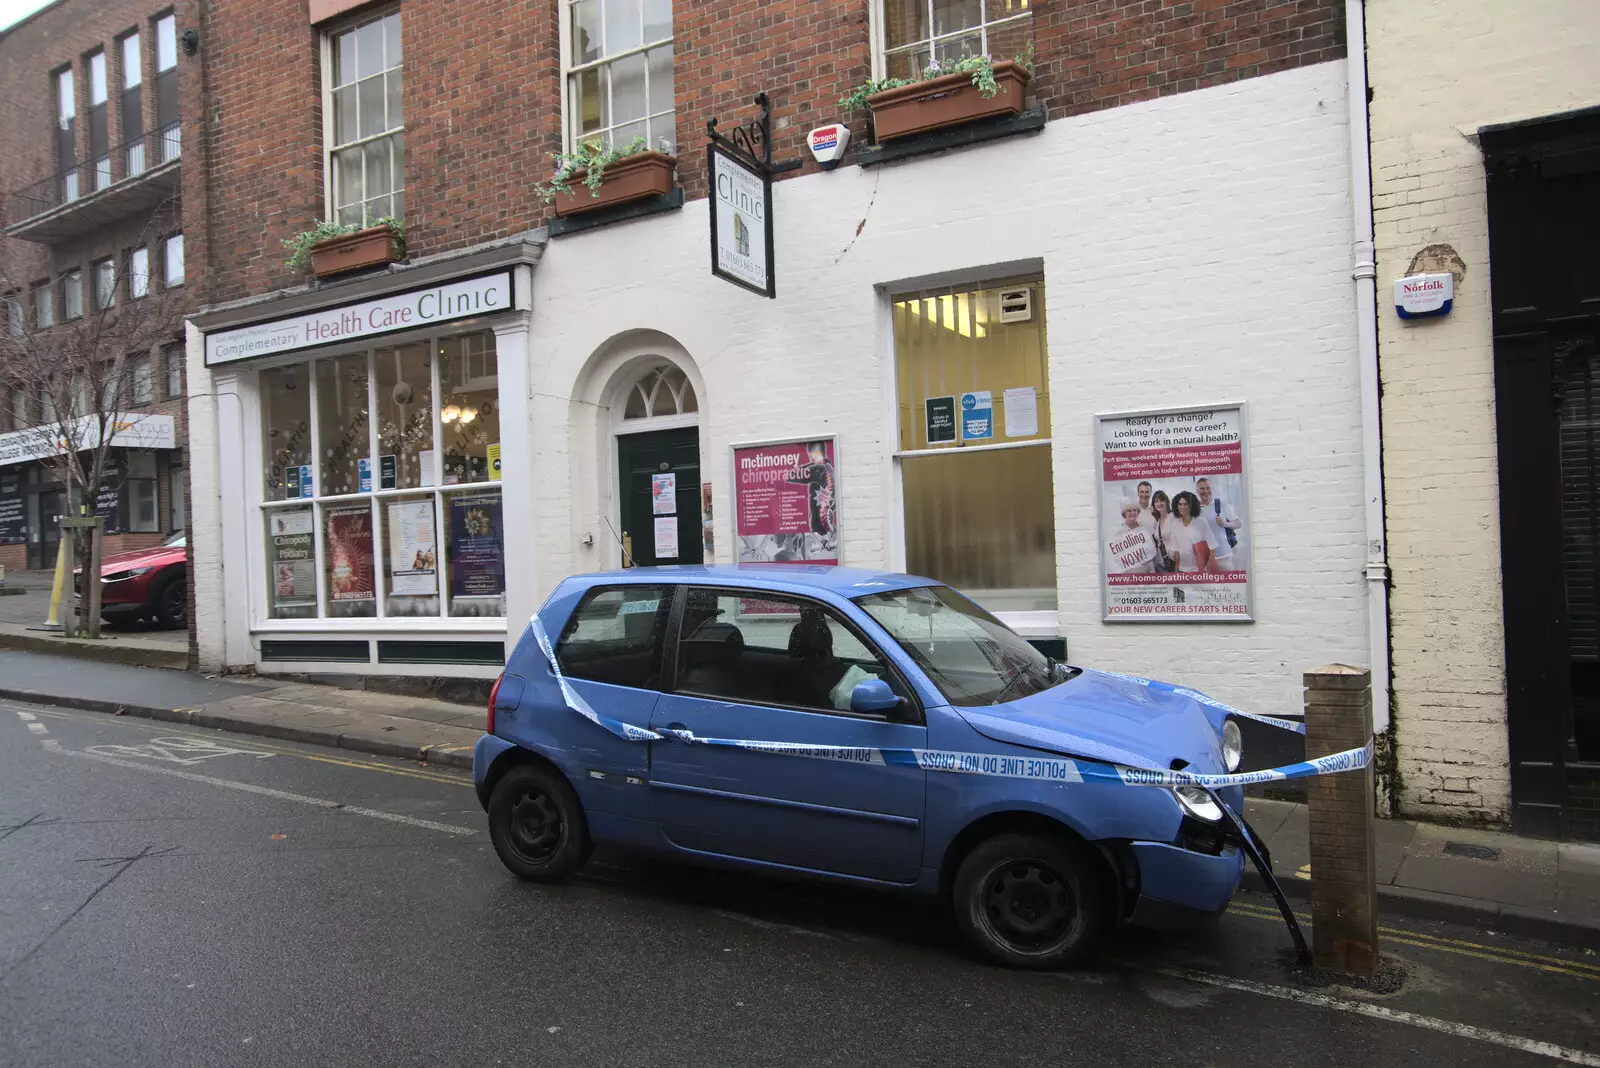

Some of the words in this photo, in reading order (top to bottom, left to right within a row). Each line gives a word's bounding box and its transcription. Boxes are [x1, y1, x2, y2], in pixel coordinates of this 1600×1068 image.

[813, 133, 837, 143] Dragon
[718, 173, 762, 219] Clinic
[1404, 281, 1444, 293] Norfolk
[216, 333, 298, 357] Complementary
[306, 311, 362, 341] Health
[368, 306, 412, 329] Care
[418, 288, 497, 319] Clinic
[1126, 416, 1151, 428] Ready
[1154, 416, 1168, 424] for
[1176, 412, 1214, 424] change?
[1114, 428, 1148, 438] Looking
[1150, 427, 1164, 436] for
[1194, 422, 1227, 432] career?
[1104, 440, 1126, 450] Want
[1128, 440, 1138, 448] to
[1140, 438, 1161, 447] work
[1173, 436, 1204, 445] natural
[1206, 432, 1238, 442] health?
[741, 453, 800, 469] mctimoney
[1158, 452, 1176, 460] study
[1176, 451, 1199, 460] leading
[1208, 448, 1241, 456] recognised
[1113, 462, 1148, 470] qualification
[1162, 459, 1194, 468] Registered
[1194, 456, 1231, 466] Homeopath
[1160, 467, 1178, 475] today
[1194, 464, 1231, 472] prospectus?
[742, 468, 811, 485] chiropractic
[274, 534, 312, 547] Chiropody
[1108, 532, 1146, 555] Enrolling
[280, 549, 308, 560] Podiatry
[1120, 548, 1148, 569] NOW!
[1108, 572, 1246, 583] www.homeopathic-college.com
[1108, 605, 1132, 614] YOUR
[1134, 605, 1152, 613] NEW
[1154, 605, 1187, 613] CAREER
[1188, 604, 1220, 613] STARTS
[1222, 604, 1248, 613] HERE!
[813, 748, 836, 760] LINE
[838, 748, 871, 762] POLICE
[921, 752, 956, 770] CROSS
[958, 754, 980, 772] NOT
[982, 756, 998, 774] DO
[1000, 758, 1025, 776] LINE
[1028, 760, 1066, 778] POLICE
[1318, 754, 1350, 772] CROSS
[1125, 769, 1164, 784] CROSS
[1168, 772, 1192, 785] NOT
